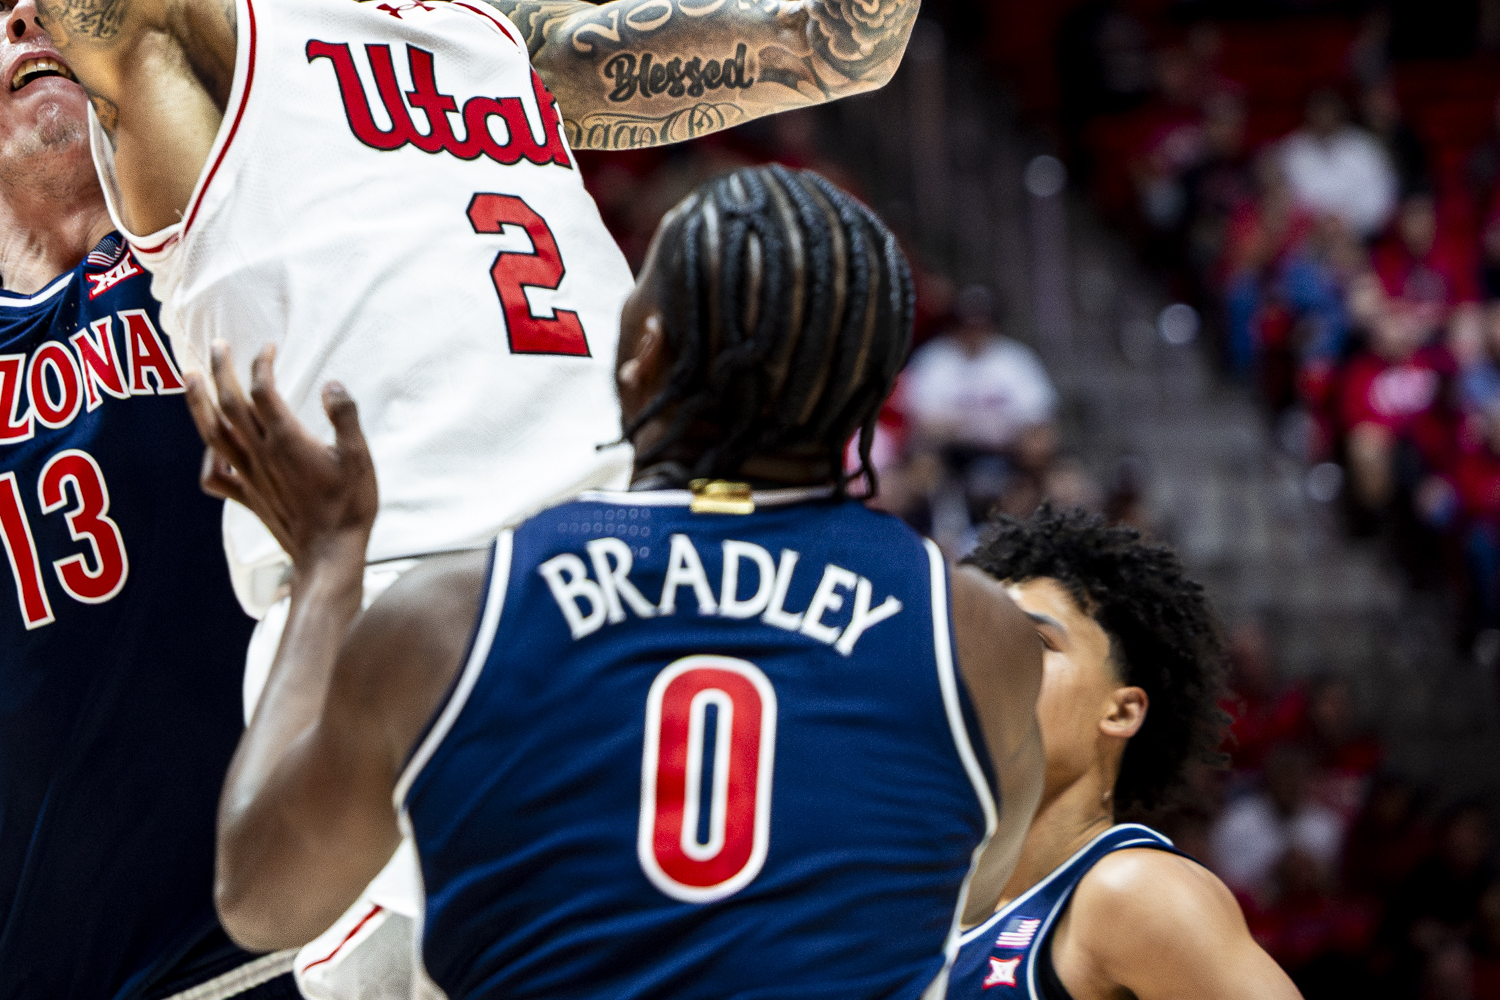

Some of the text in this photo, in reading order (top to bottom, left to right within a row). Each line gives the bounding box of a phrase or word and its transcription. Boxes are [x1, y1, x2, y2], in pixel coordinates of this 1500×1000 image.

[604, 43, 754, 102] Blessed
[87, 249, 141, 298] XII
[465, 192, 593, 358] 2
[538, 533, 903, 658] BRADLEY
[637, 654, 778, 905] 0
